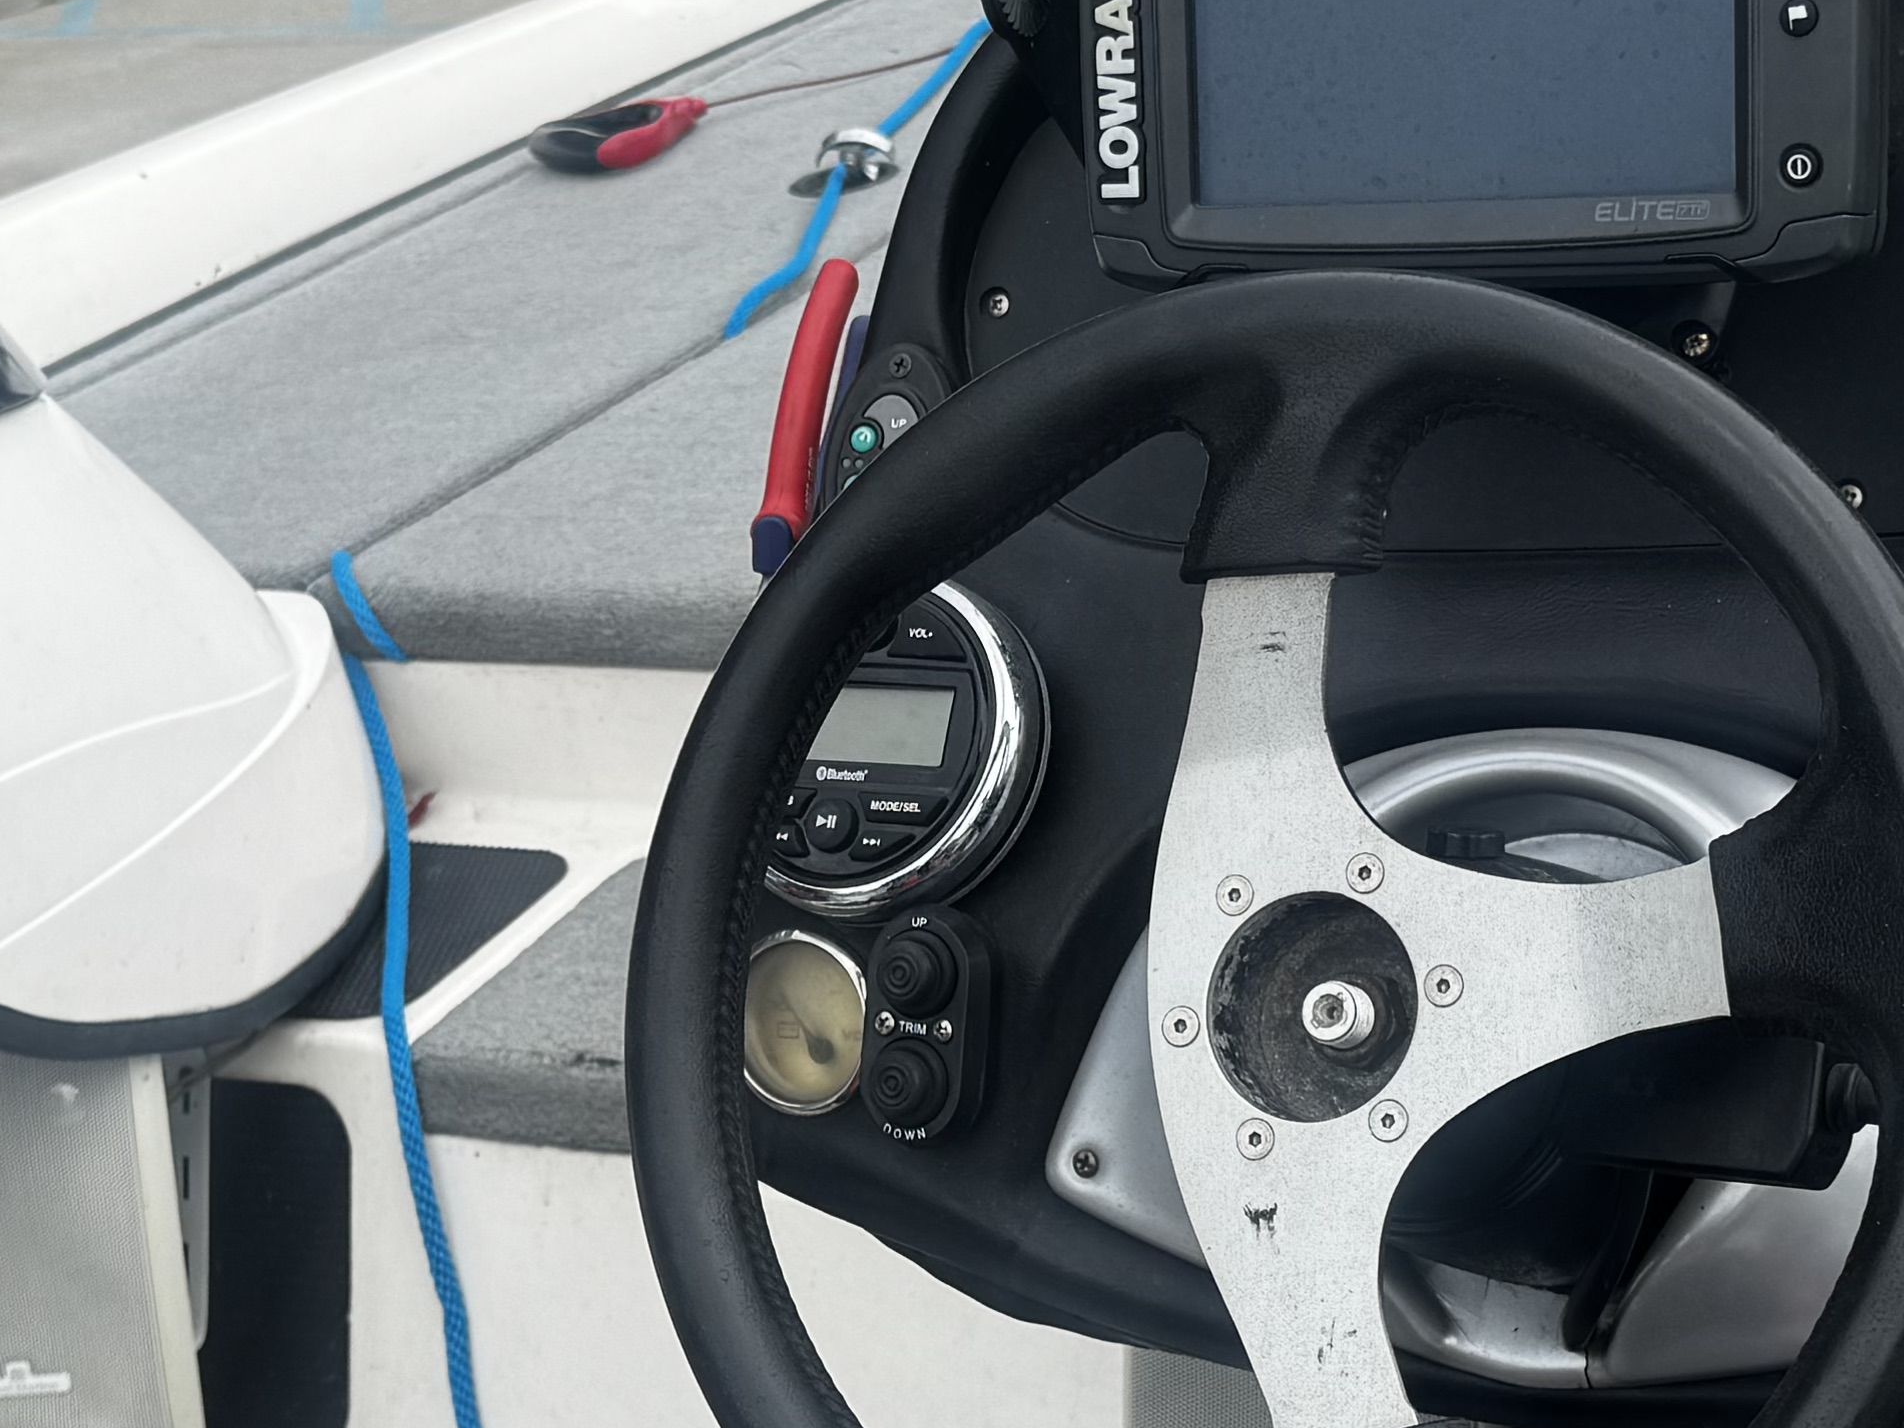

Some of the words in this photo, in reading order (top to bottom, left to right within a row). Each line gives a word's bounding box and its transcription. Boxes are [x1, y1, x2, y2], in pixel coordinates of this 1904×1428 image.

[1594, 197, 1677, 222] ELITE
[891, 418, 907, 429] UP
[870, 800, 921, 813] MODE/SEL
[911, 917, 928, 928] UP
[899, 1021, 927, 1036] TRIM
[883, 1122, 926, 1140] DOWN
